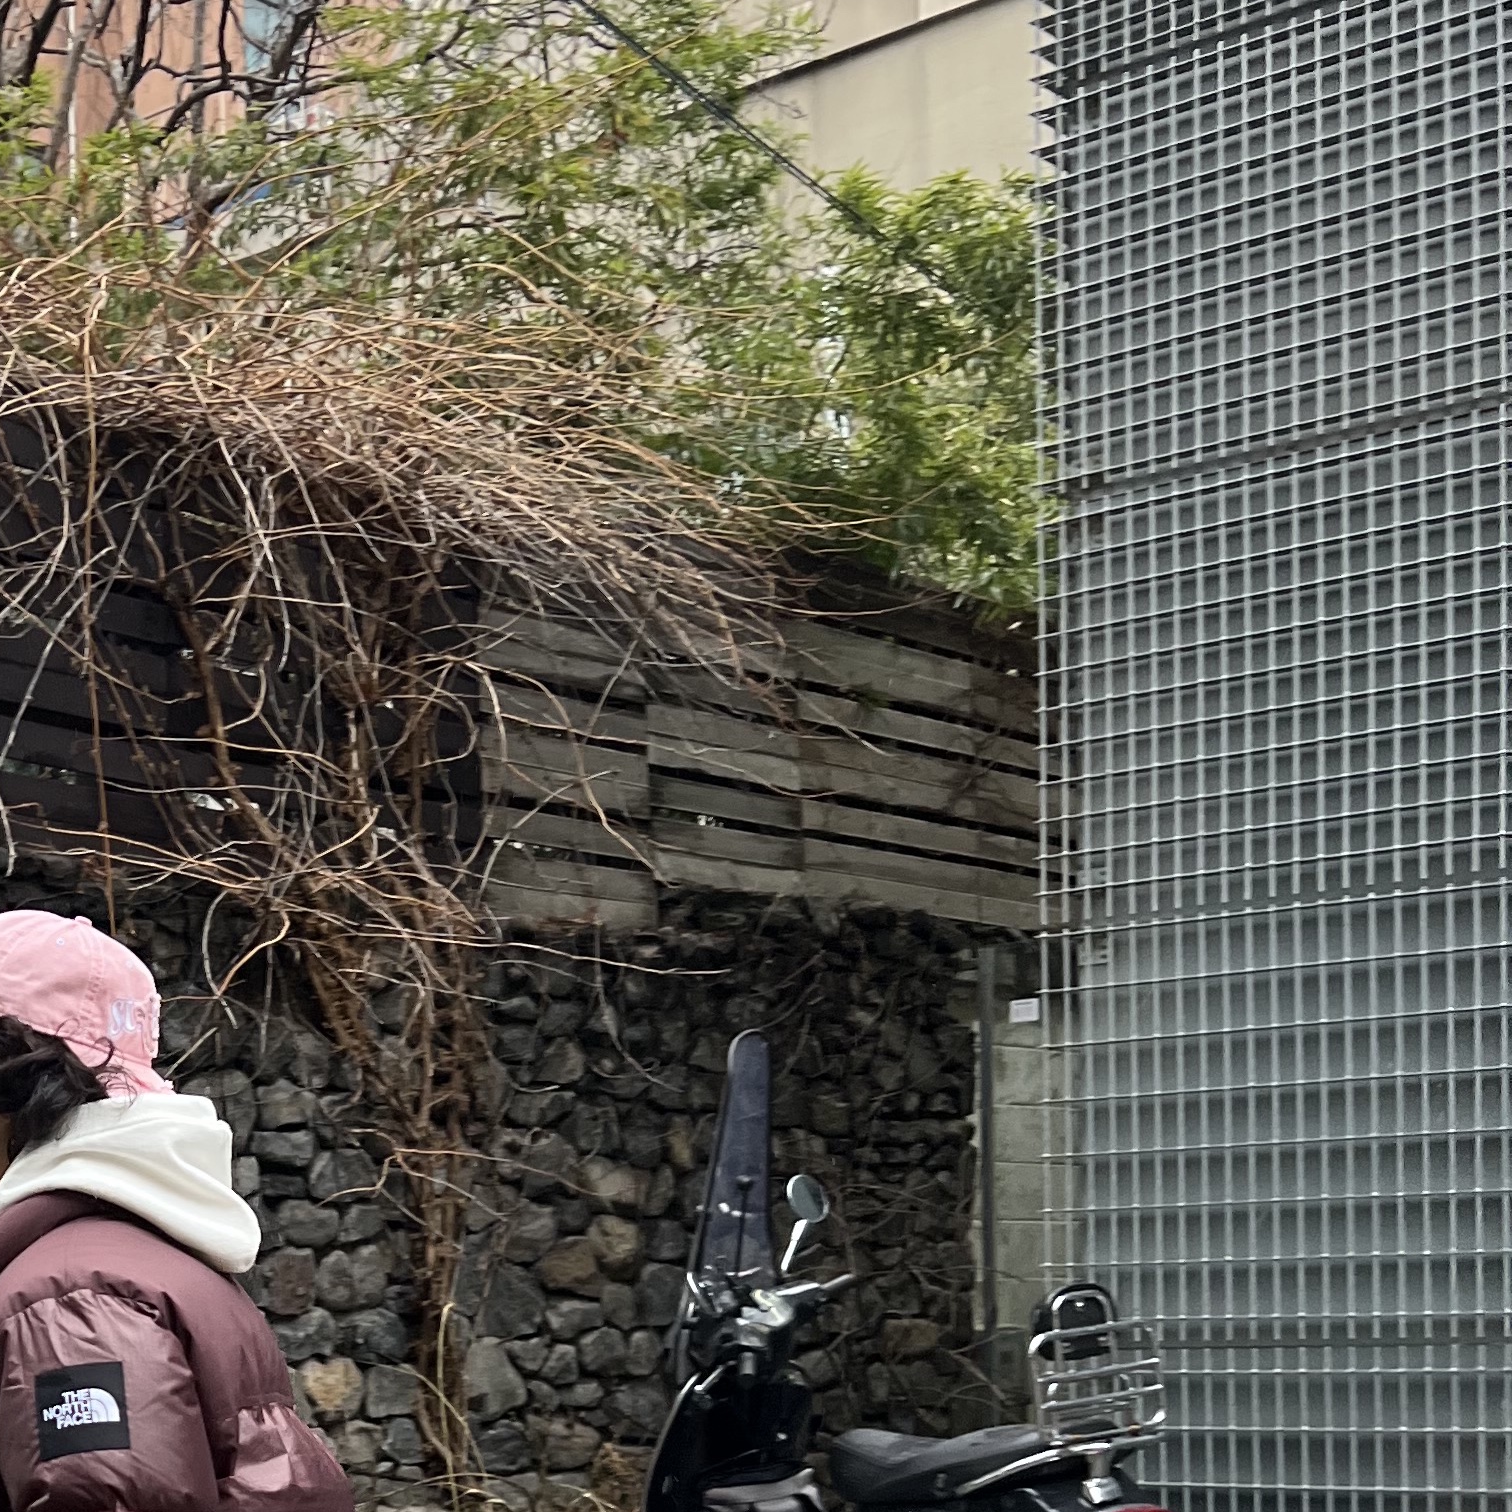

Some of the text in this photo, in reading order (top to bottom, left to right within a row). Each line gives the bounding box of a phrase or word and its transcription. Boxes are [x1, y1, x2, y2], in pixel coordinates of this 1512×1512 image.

[61, 1389, 90, 1405] THE
[42, 1400, 91, 1422] NORTH
[56, 1412, 92, 1430] FACE
